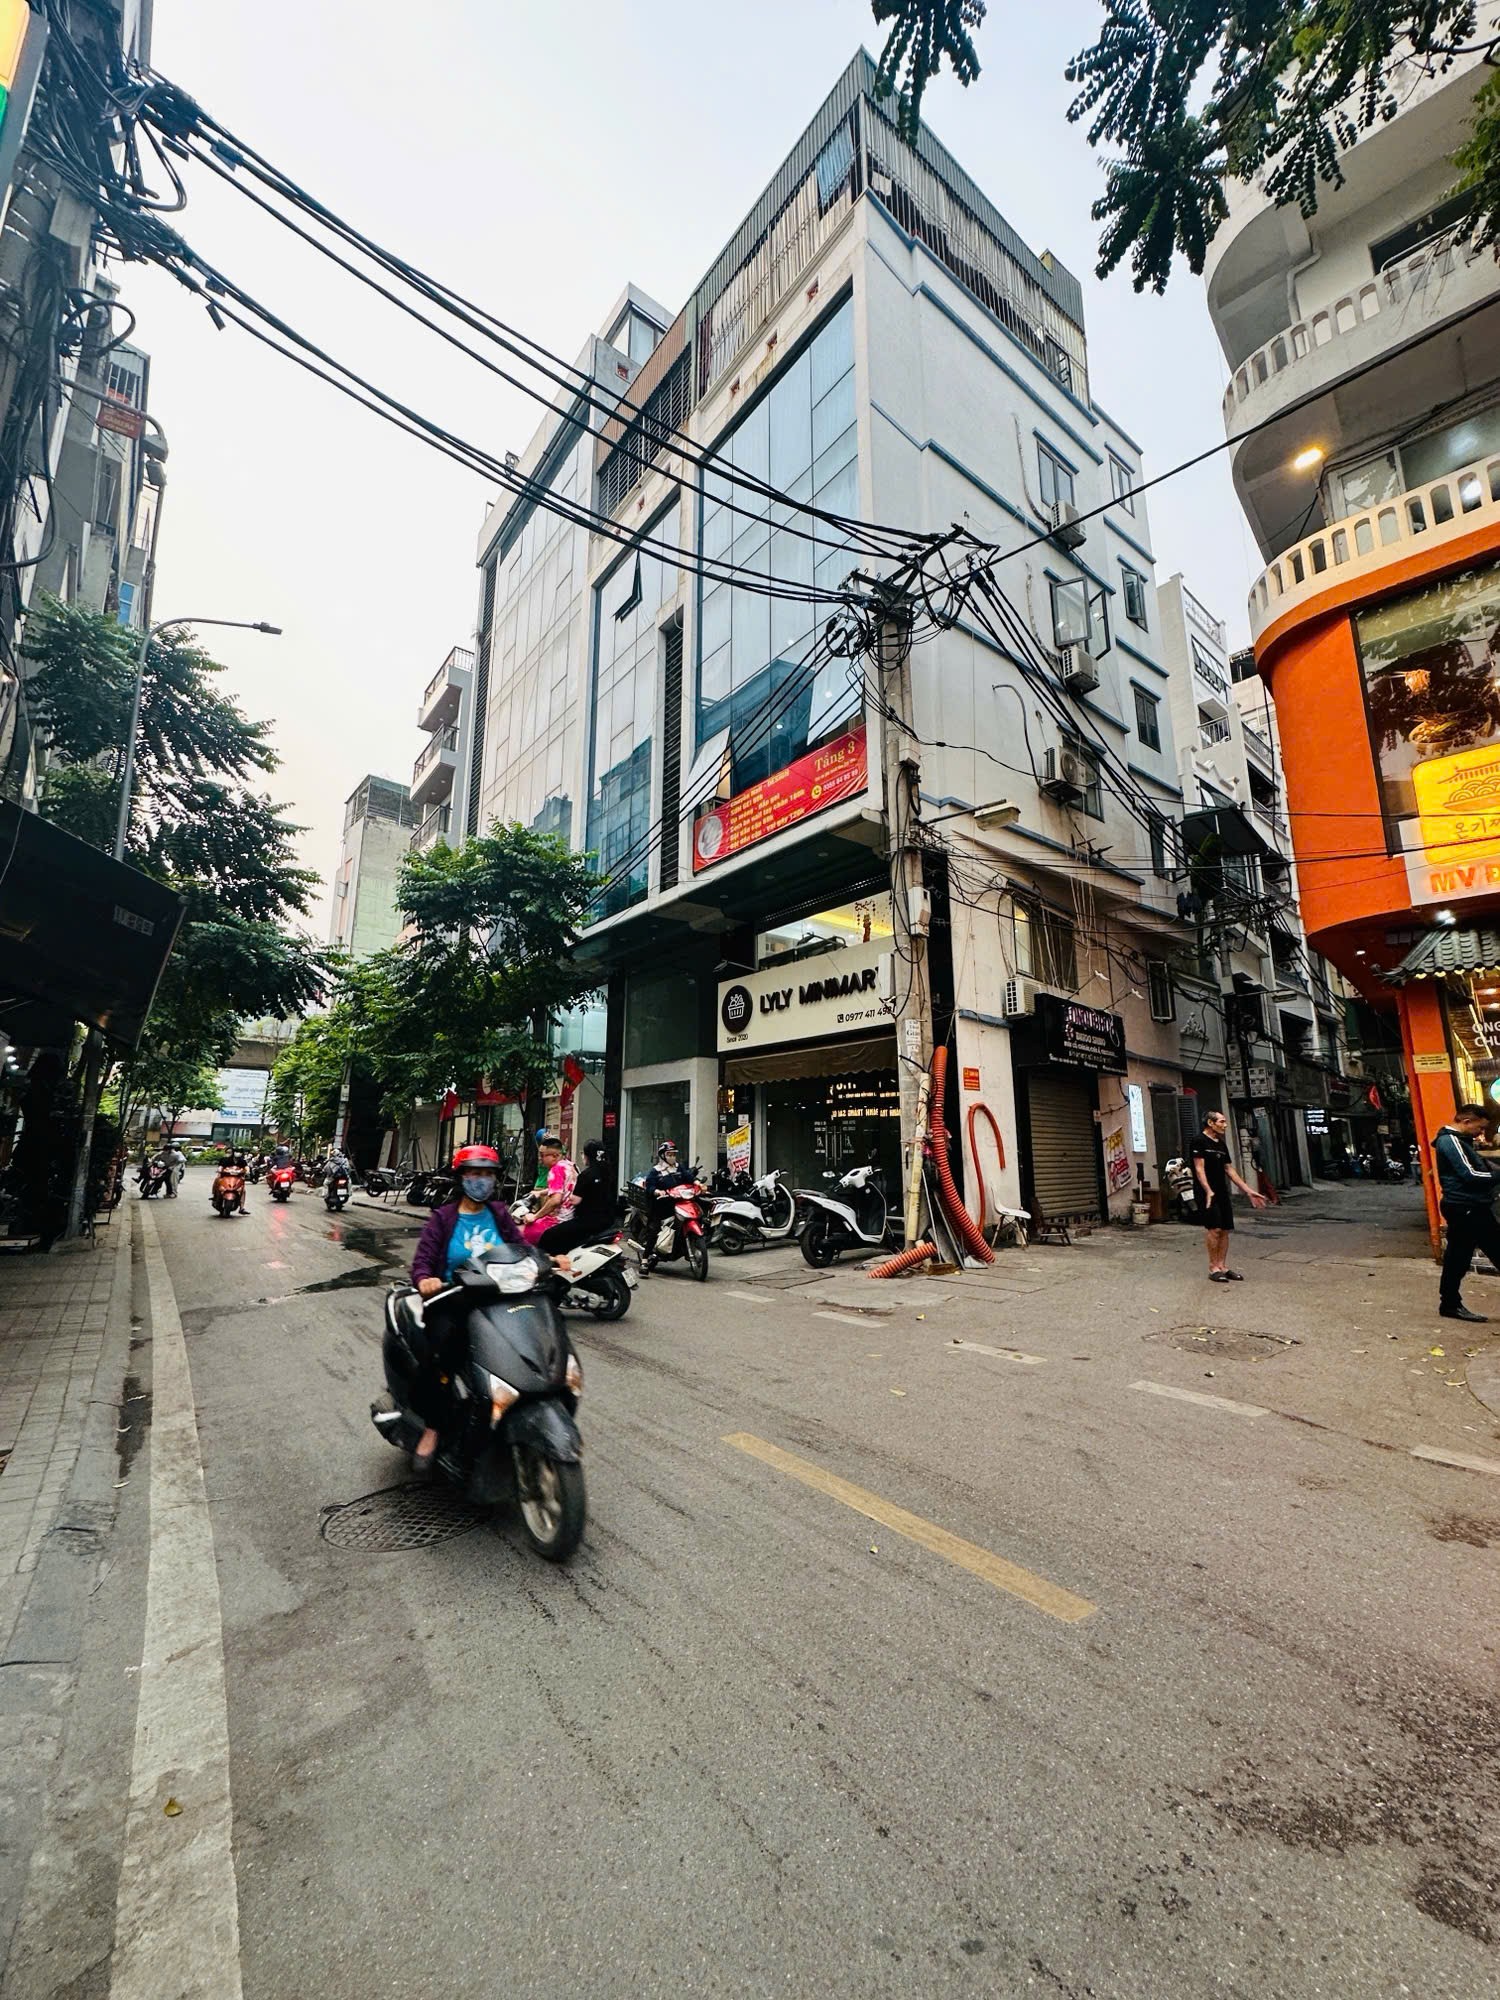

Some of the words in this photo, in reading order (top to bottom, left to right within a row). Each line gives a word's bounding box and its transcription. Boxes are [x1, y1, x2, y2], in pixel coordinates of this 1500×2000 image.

[815, 747, 845, 772] Tầng
[760, 987, 794, 1014] LYLY
[799, 966, 879, 1005] MINIMAR
[845, 1011, 864, 1022] 0977
[865, 1009, 876, 1019] 411
